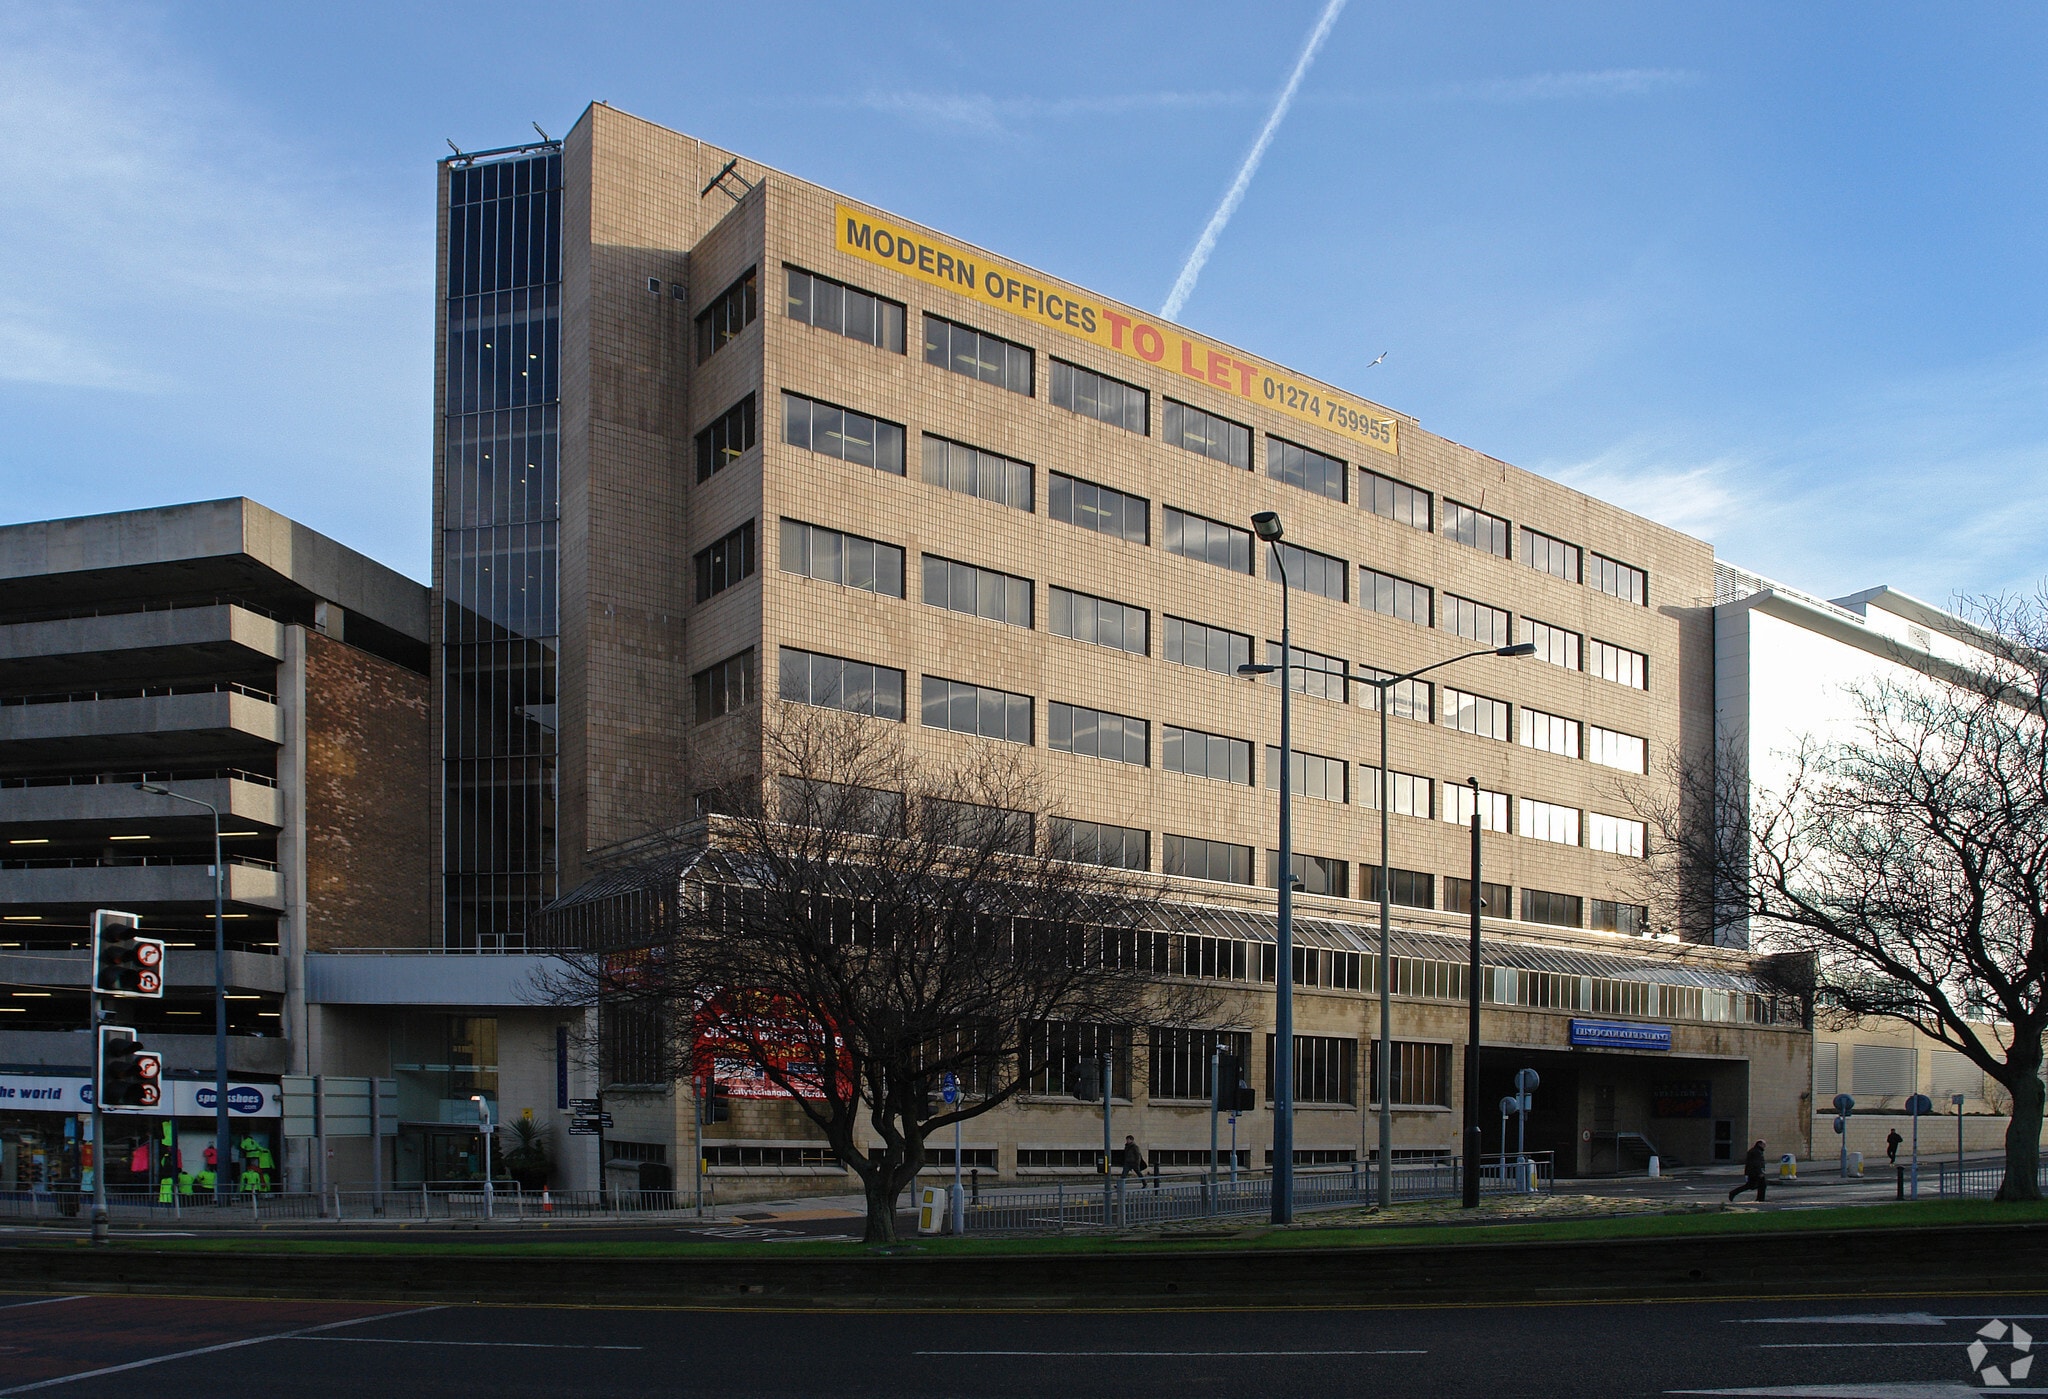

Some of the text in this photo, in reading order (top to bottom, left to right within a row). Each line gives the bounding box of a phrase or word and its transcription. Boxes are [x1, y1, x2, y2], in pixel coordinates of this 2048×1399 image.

[847, 218, 1390, 444] MODERN OFFICES TO LET 01274 759955
[0, 1086, 62, 1100] he world
[198, 1093, 259, 1104] sposshoes
